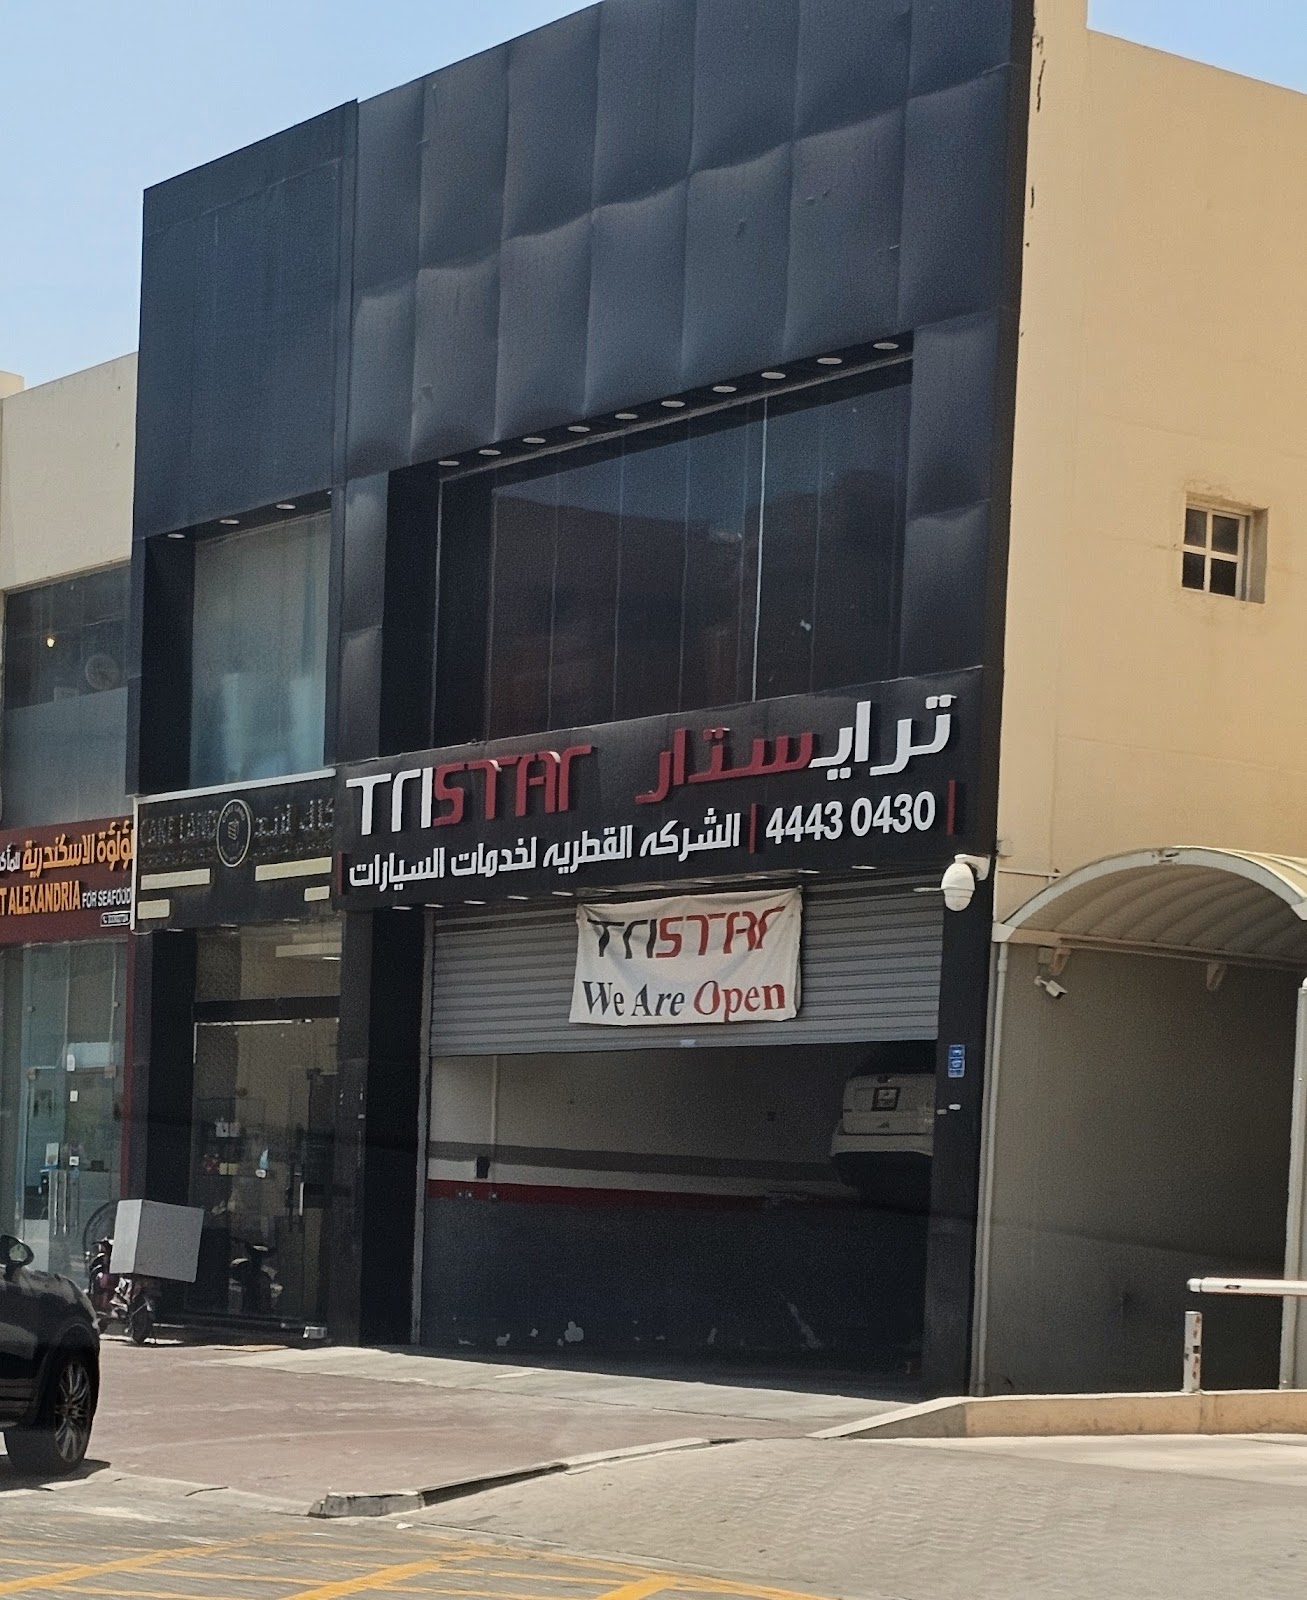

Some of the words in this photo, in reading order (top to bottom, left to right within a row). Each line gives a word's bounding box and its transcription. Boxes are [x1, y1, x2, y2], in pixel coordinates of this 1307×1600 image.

[346, 745, 592, 836] TRISTAR
[765, 800, 844, 845] 4443
[850, 790, 936, 837] 0430
[22, 833, 95, 879] الاسكندرية
[349, 847, 445, 892] السيارات
[450, 836, 538, 878] لخدمات
[8, 880, 81, 915] ALEXANDRIA
[82, 891, 97, 908] FOR
[97, 887, 132, 908] SEAFOOD
[586, 905, 786, 960] TRISTAR
[582, 980, 626, 1016] We
[631, 984, 685, 1017] Are
[694, 980, 786, 1022] Open
